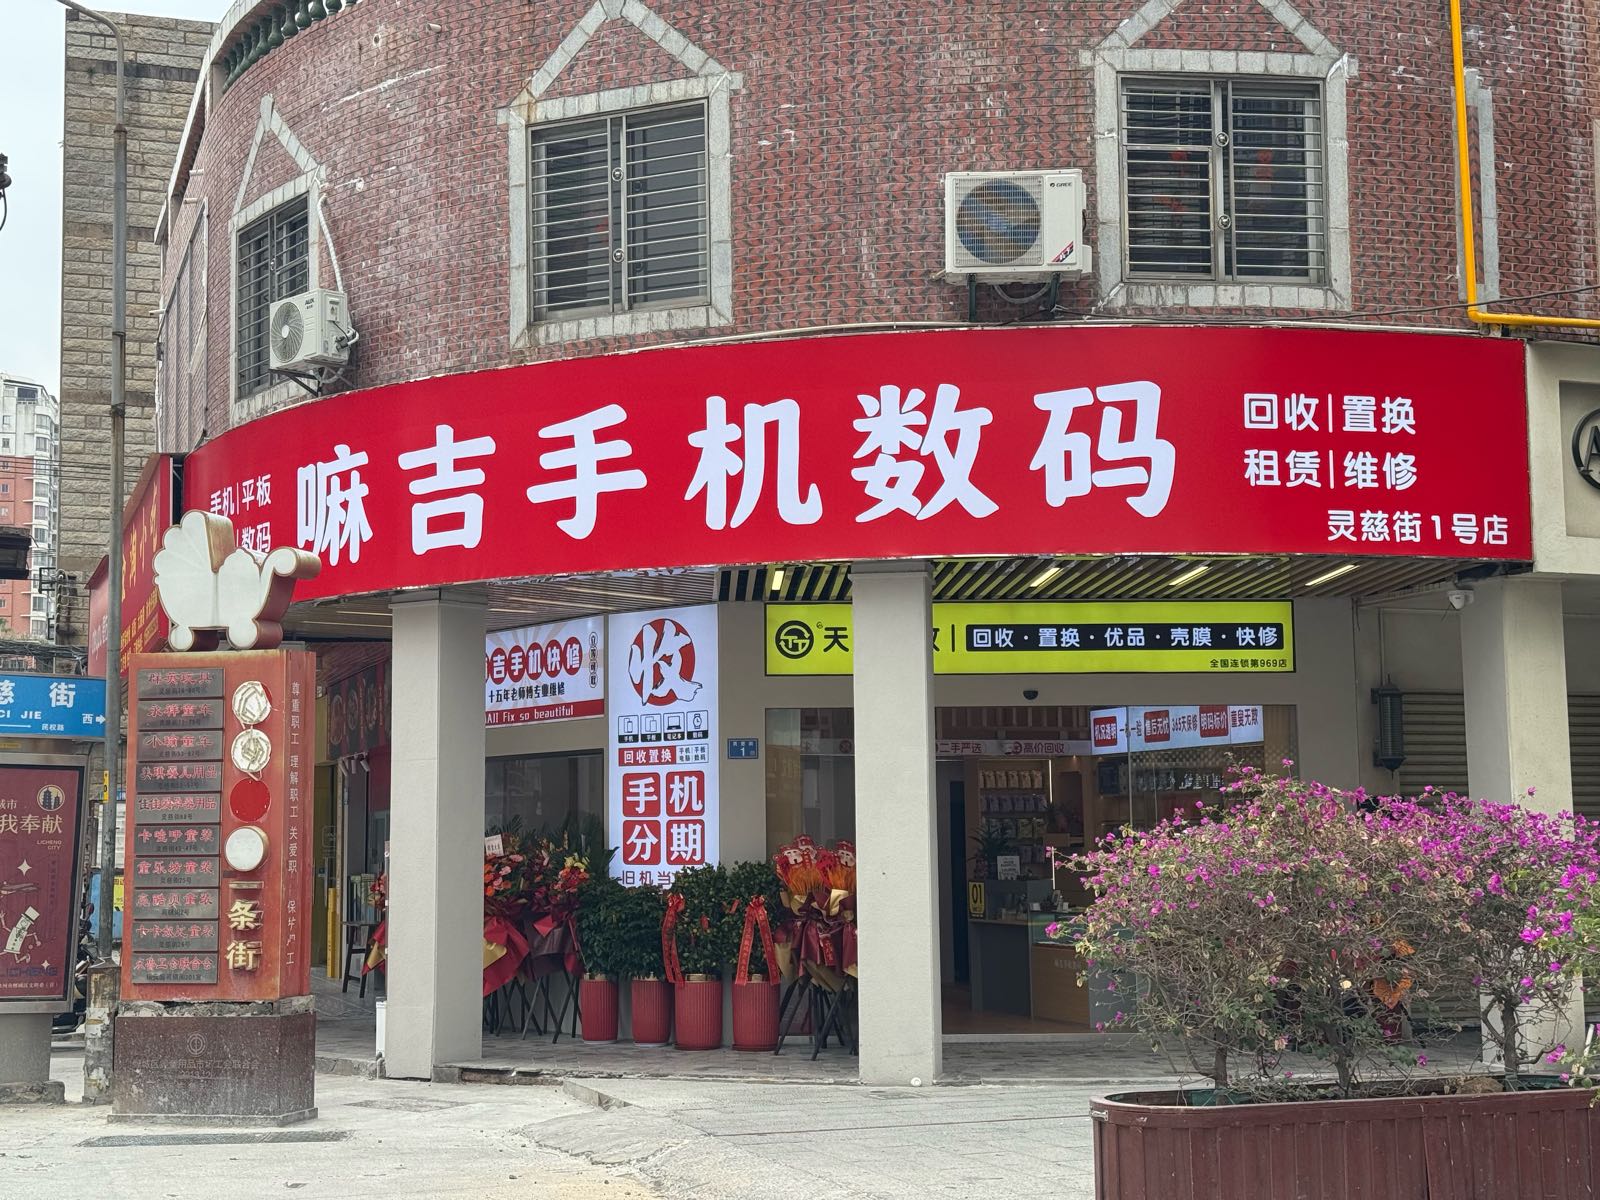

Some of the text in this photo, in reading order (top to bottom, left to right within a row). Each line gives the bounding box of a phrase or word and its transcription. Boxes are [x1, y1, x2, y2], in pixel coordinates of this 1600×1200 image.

[297, 380, 1177, 567] 嘛吉手机数码
[1327, 509, 1509, 545] 灵慈街1号店
[486, 642, 580, 679] 吉手机快修
[1209, 658, 1288, 668] 全国连锁第969店
[20, 711, 42, 720] JIE
[82, 713, 94, 724] 西
[502, 711, 515, 722] Fix
[519, 711, 530, 720] so
[534, 704, 574, 719] beautiful
[1200, 711, 1228, 731] 明码标价
[623, 748, 672, 764] 回收置换
[1023, 743, 1065, 754] 高价回收
[626, 775, 703, 815] 手机
[627, 822, 703, 862] 分期
